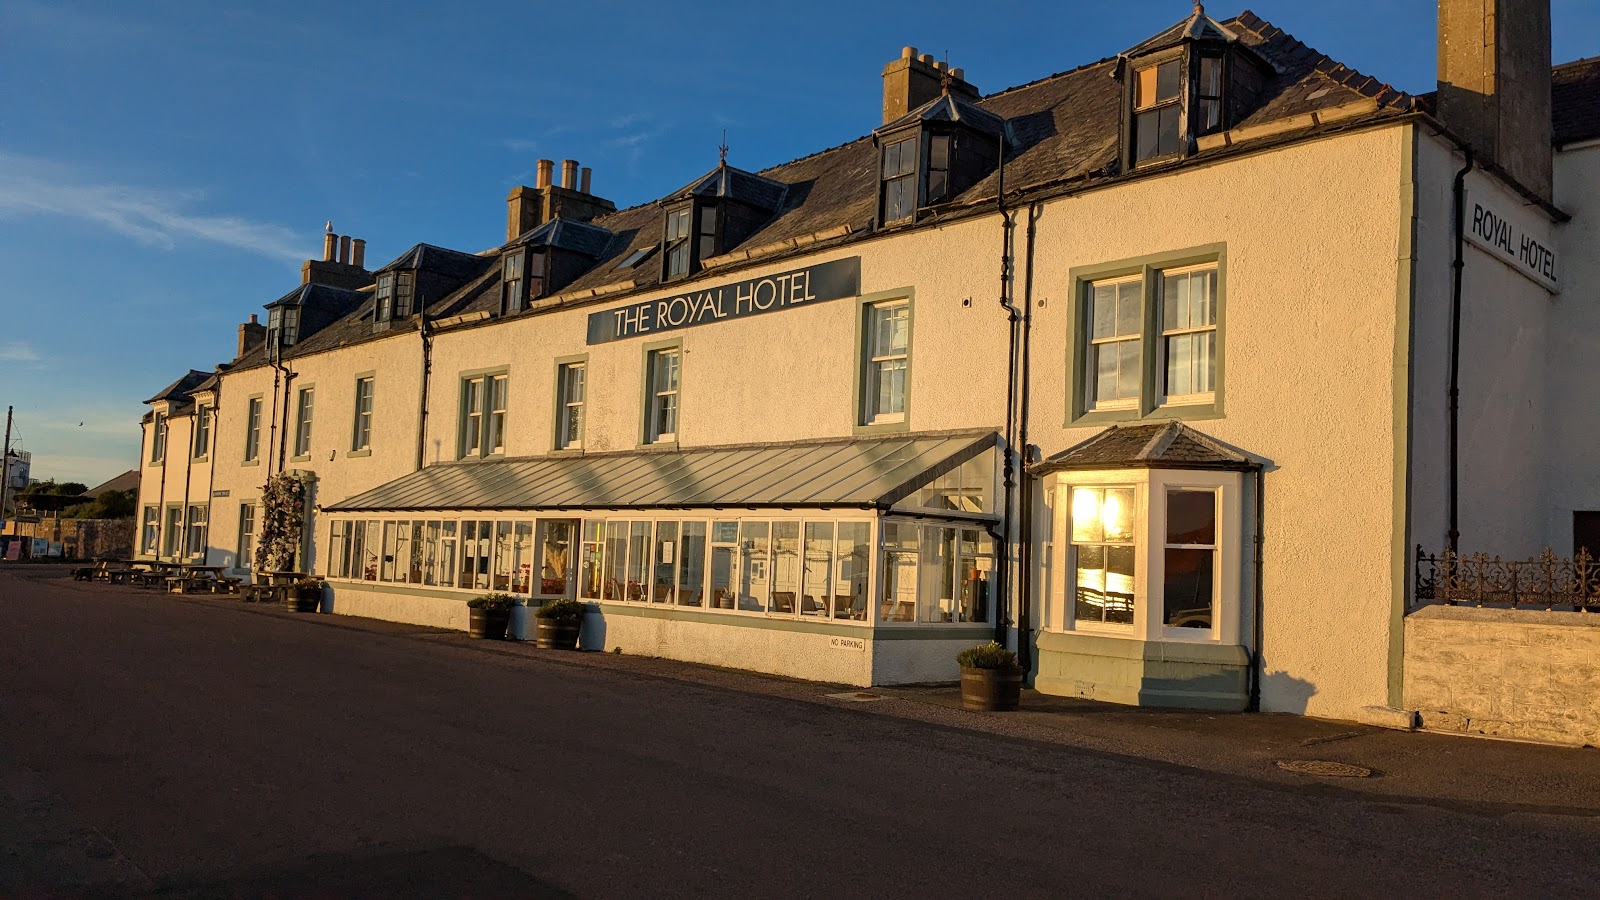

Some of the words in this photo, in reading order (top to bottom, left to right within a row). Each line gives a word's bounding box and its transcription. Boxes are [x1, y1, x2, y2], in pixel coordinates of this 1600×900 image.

[1472, 203, 1515, 256] ROYAL
[1519, 233, 1557, 282] HOTEL
[614, 304, 652, 337] THE
[656, 289, 728, 329] ROYAL
[735, 270, 816, 315] HOTEL
[830, 638, 839, 646] NO
[840, 639, 863, 649] PARKING
